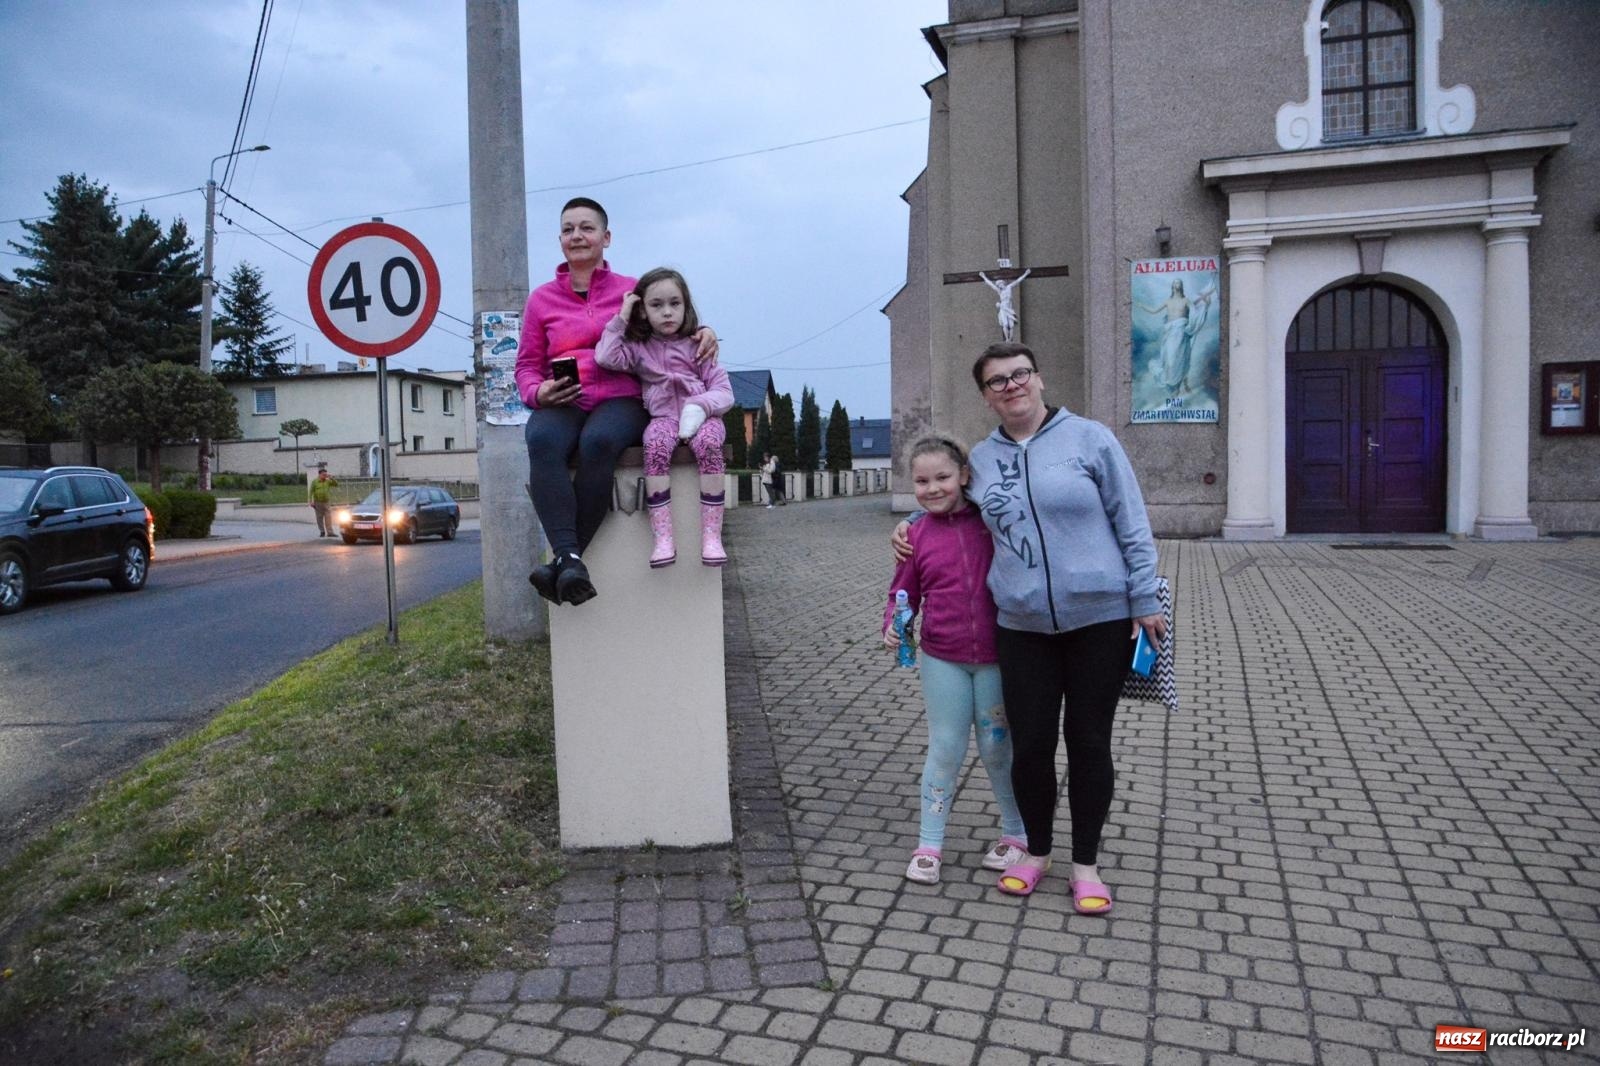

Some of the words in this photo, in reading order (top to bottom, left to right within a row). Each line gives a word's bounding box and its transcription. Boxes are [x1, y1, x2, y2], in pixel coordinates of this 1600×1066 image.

[1135, 259, 1217, 273] ALLELUJA
[329, 256, 421, 322] 40
[1166, 398, 1183, 407] PAN
